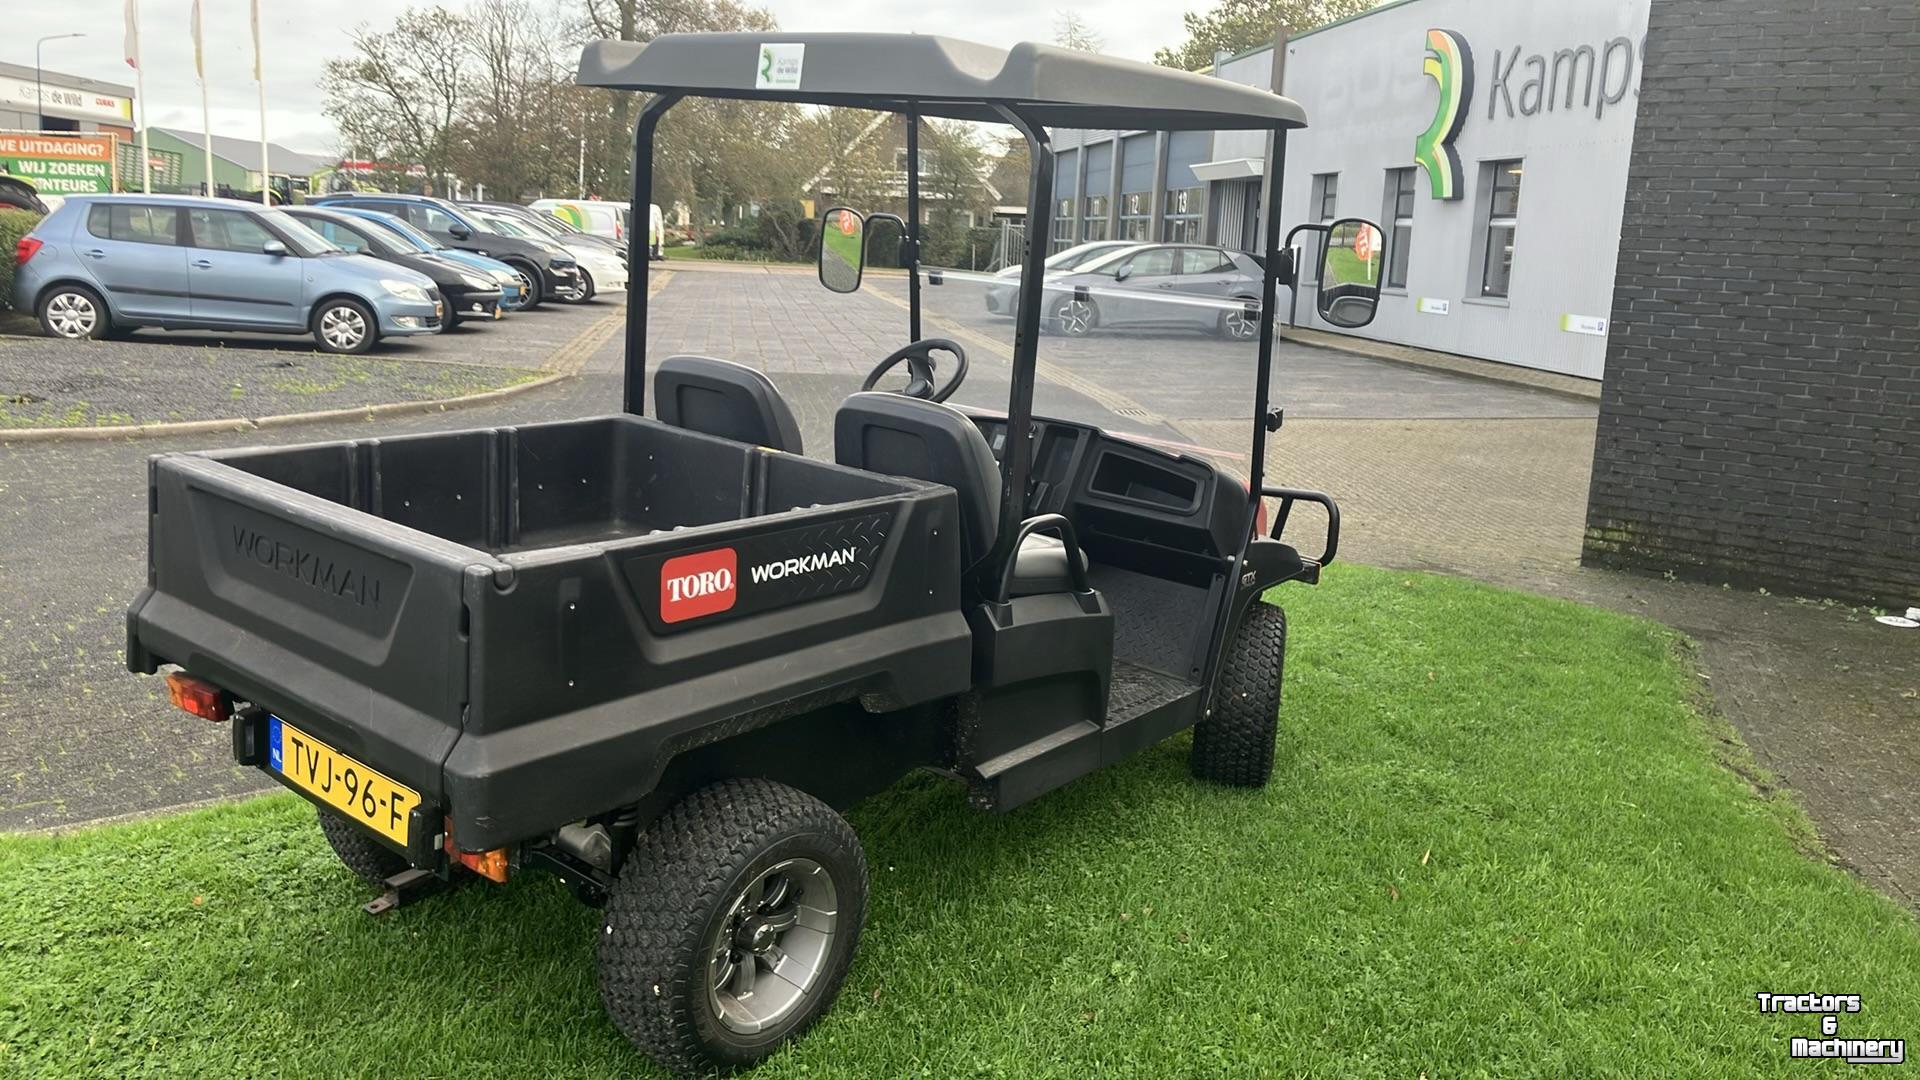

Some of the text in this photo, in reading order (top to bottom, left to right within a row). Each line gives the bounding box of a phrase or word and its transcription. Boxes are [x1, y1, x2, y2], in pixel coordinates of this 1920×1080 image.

[19, 140, 104, 157] UITDAGING?
[18, 160, 105, 177] WIJ ZOEKEN
[1178, 191, 1187, 213] 13
[233, 525, 380, 607] WORKMAN
[667, 548, 856, 602] TORO WORKMAN
[291, 736, 405, 831] TVJ-96-F
